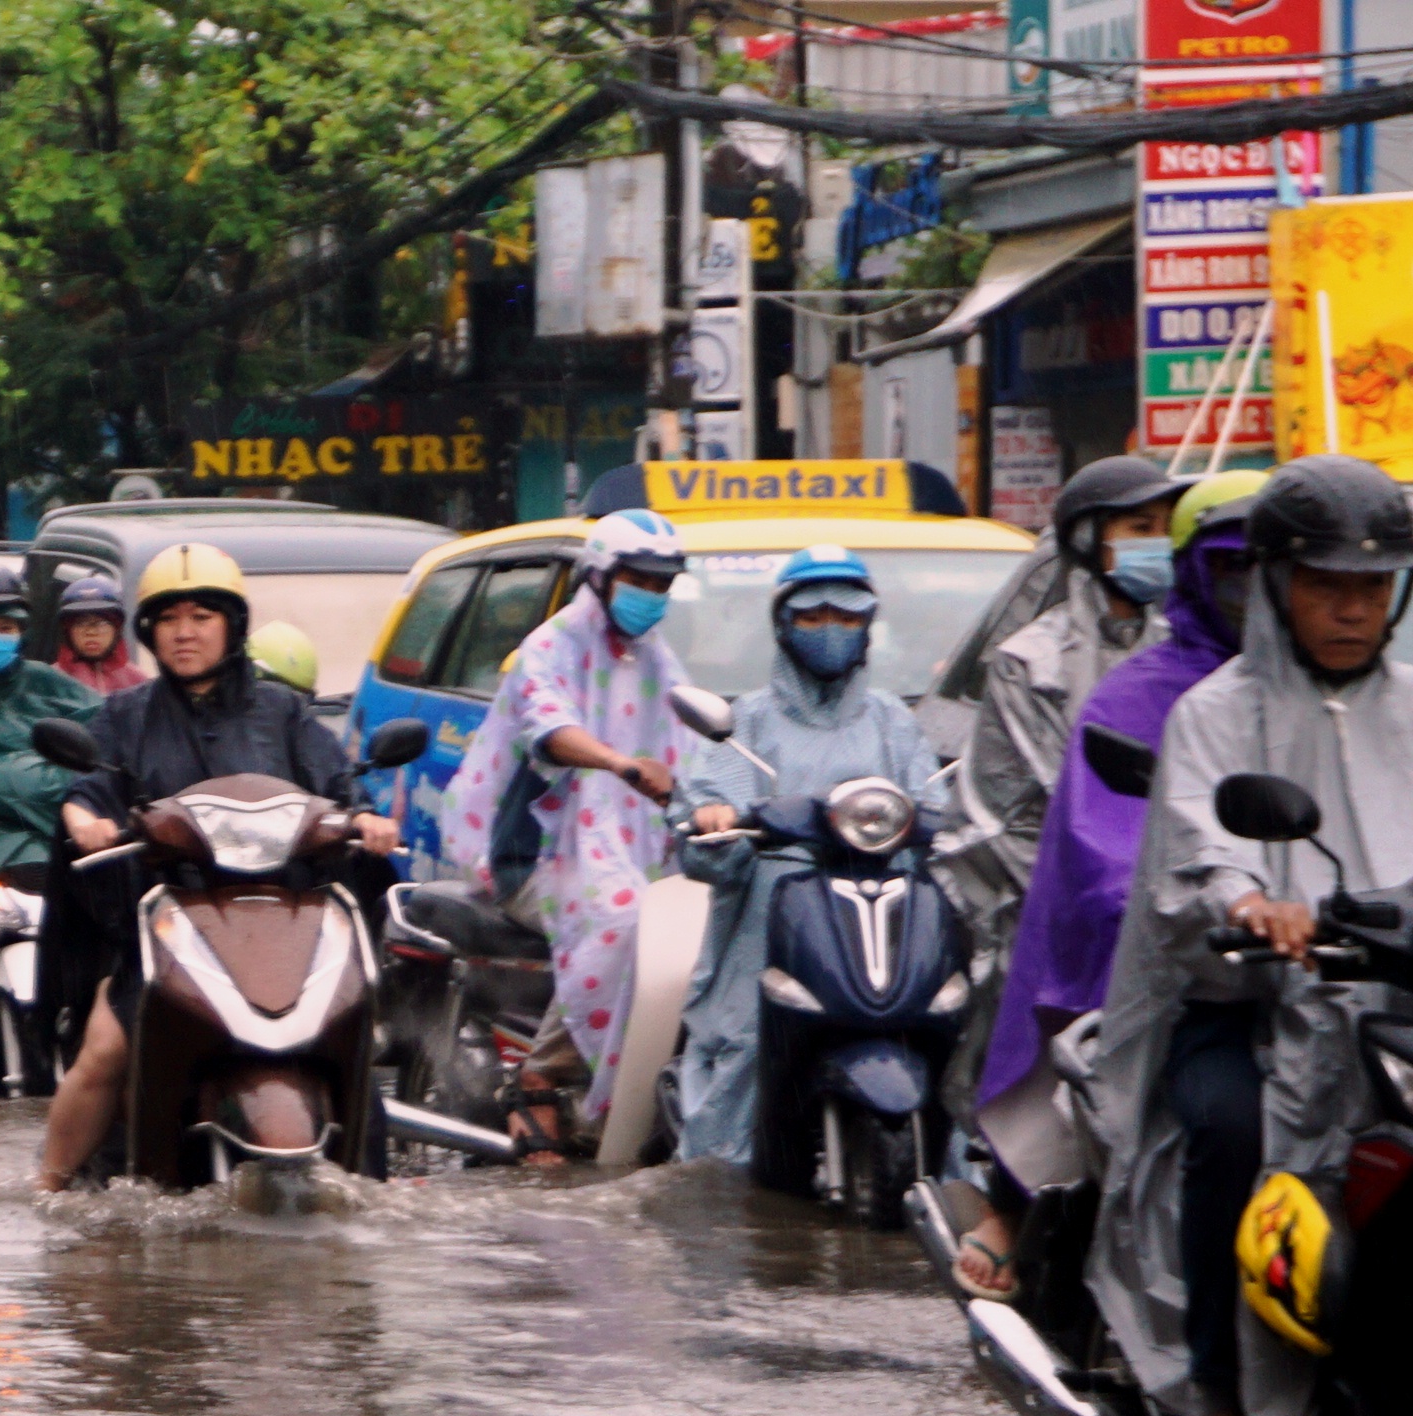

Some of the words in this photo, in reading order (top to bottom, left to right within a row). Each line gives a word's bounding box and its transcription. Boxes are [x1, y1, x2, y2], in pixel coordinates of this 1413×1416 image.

[1178, 35, 1290, 56] PETRO
[1158, 143, 1244, 175] NGỌC
[191, 436, 356, 481] NHẠC
[373, 415, 486, 475] TRẺ
[668, 466, 887, 501] Vinataxi
